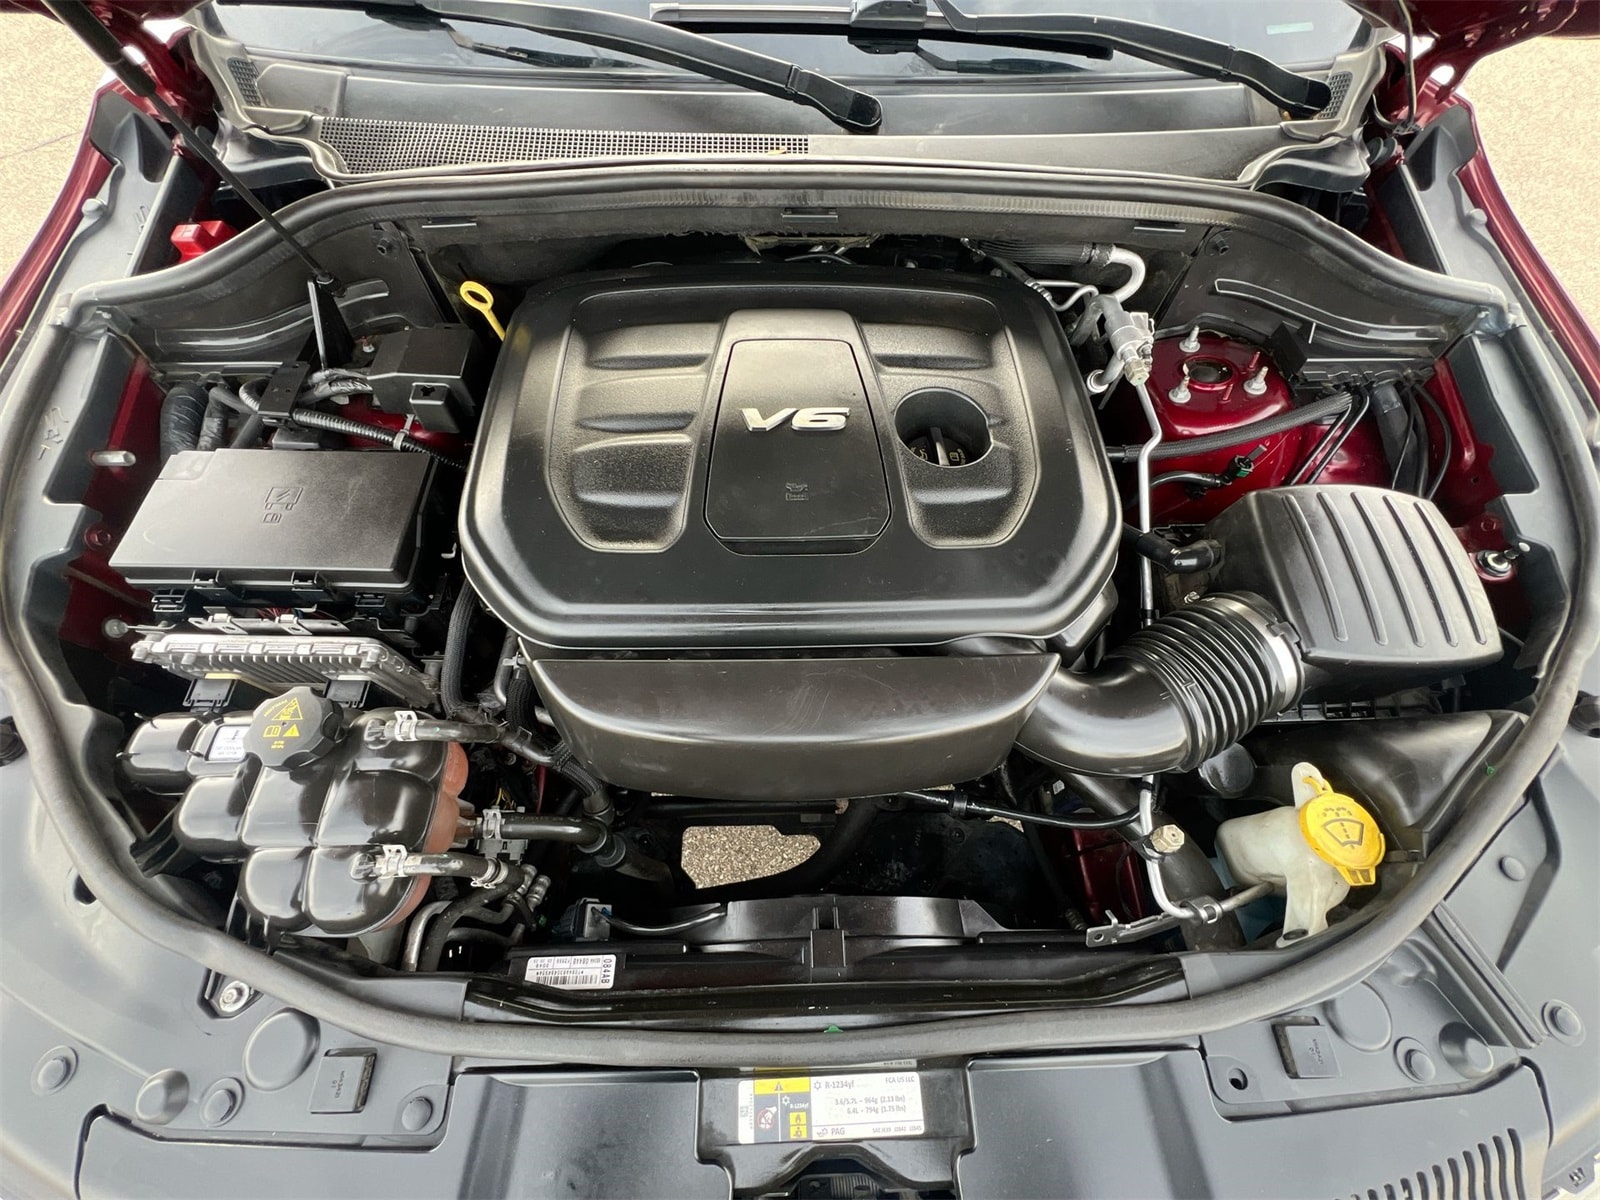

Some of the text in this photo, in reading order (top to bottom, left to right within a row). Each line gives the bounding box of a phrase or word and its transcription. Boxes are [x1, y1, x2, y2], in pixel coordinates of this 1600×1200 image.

[740, 407, 850, 432] V6
[601, 958, 613, 984] 084AB
[824, 1079, 855, 1090] R-1234yf
[905, 1075, 915, 1083] LLC
[831, 1127, 846, 1136] PAG
